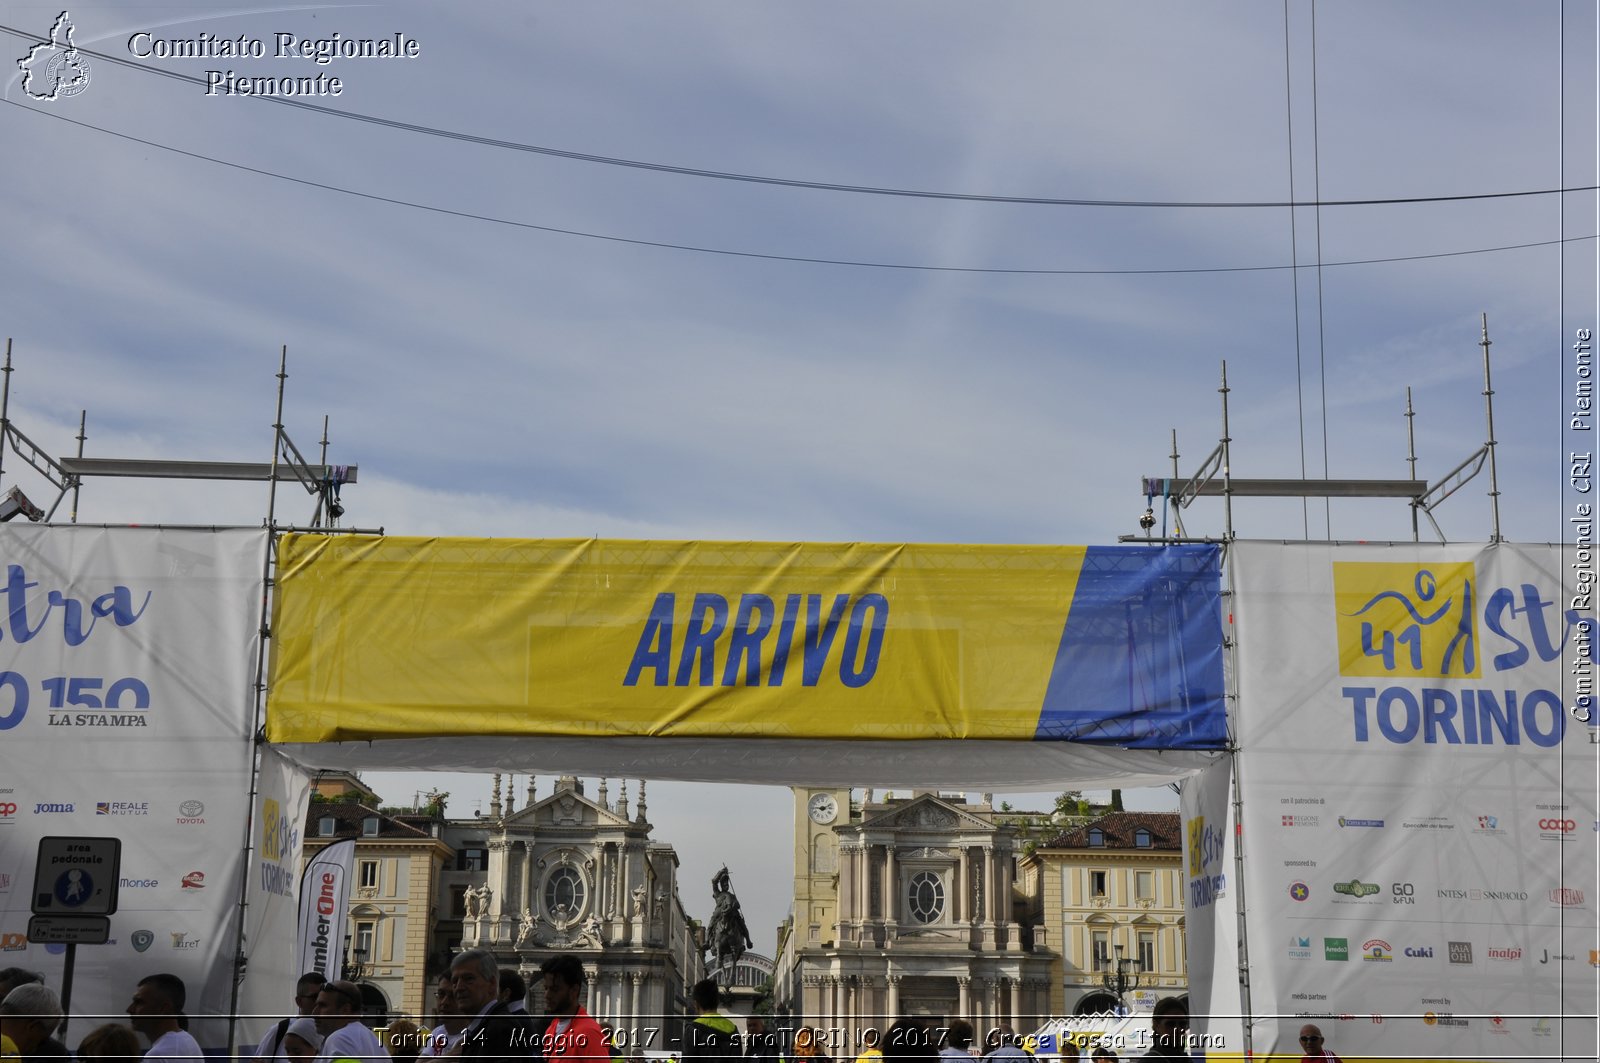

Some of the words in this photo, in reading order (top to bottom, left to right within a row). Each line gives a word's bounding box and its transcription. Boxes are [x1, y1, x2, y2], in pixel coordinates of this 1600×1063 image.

[622, 592, 889, 688] ARRIVO
[48, 714, 72, 727] LA
[75, 714, 147, 727] STAMPA
[1342, 686, 1567, 748] TORINO
[67, 844, 91, 852] area
[52, 854, 103, 864] pedonale
[1392, 883, 1414, 896] GO
[1437, 889, 1467, 899] INTESA
[1404, 947, 1433, 958] Cuki
[1488, 948, 1522, 960] inalpi
